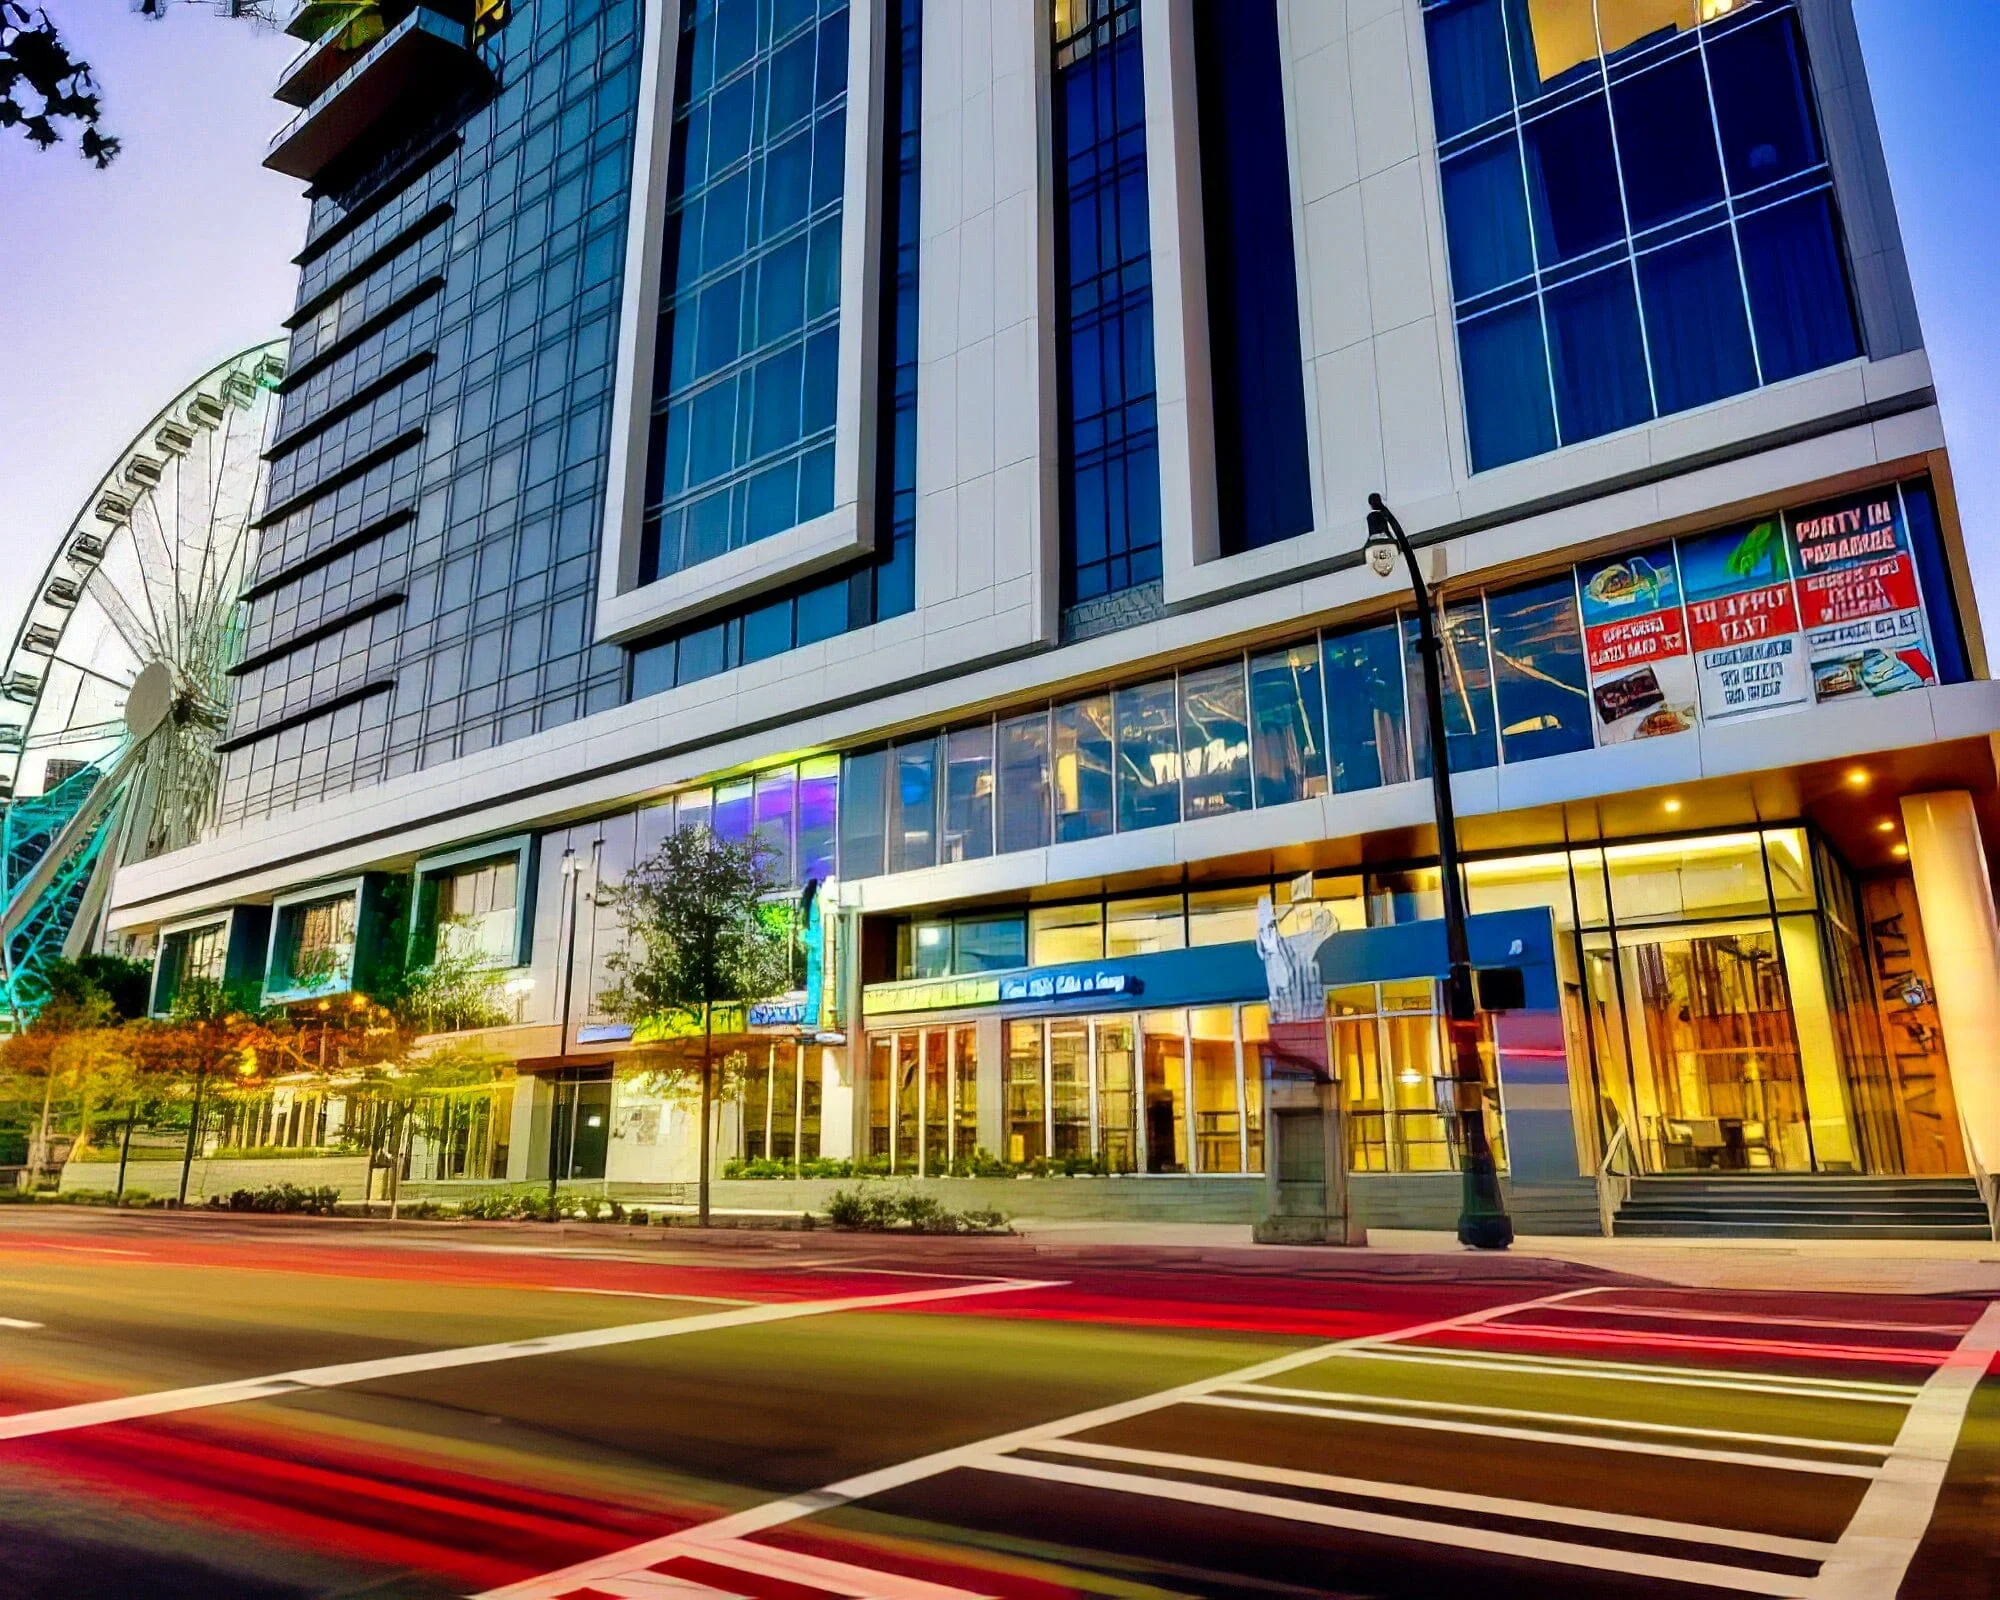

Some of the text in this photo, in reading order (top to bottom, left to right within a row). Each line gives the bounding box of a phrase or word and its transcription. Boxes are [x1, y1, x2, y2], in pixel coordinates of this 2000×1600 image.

[1796, 507, 1860, 543] PARTY
[1724, 587, 1789, 617] APPLY
[1870, 911, 1943, 1121] ATLANTA
